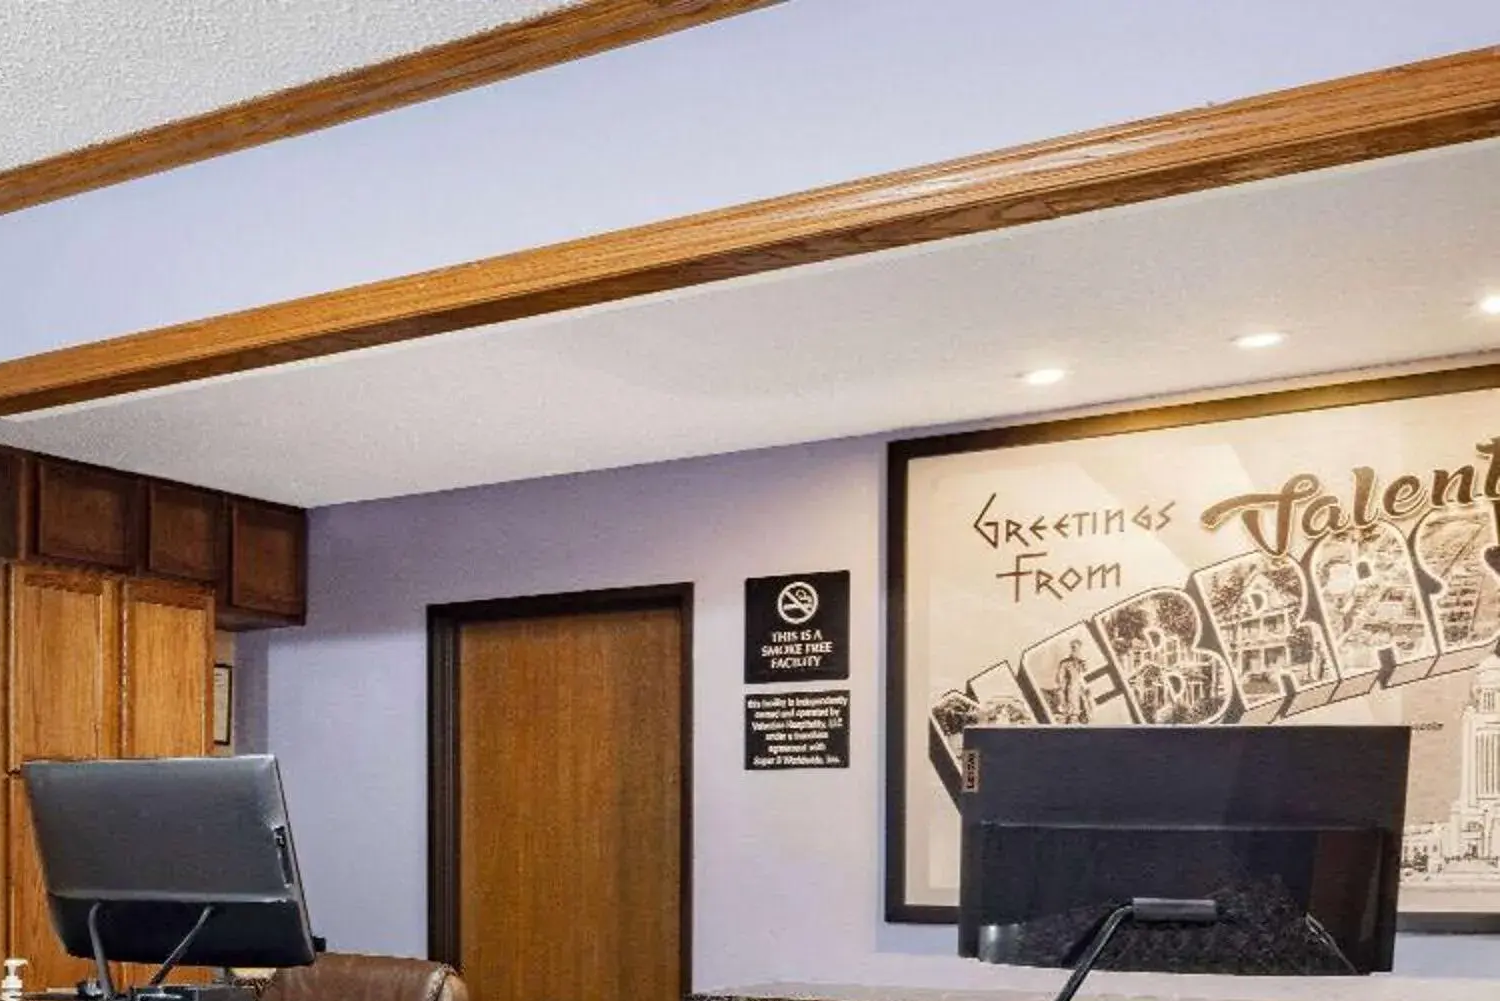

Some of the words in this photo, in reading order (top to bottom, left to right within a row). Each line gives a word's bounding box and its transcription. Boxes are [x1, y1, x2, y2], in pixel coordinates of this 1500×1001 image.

[772, 631, 798, 642] THIS
[801, 630, 812, 641] IS
[813, 630, 822, 640] A
[761, 644, 803, 656] SMOKE
[806, 642, 833, 653] FREE
[771, 656, 822, 668] FACILITY
